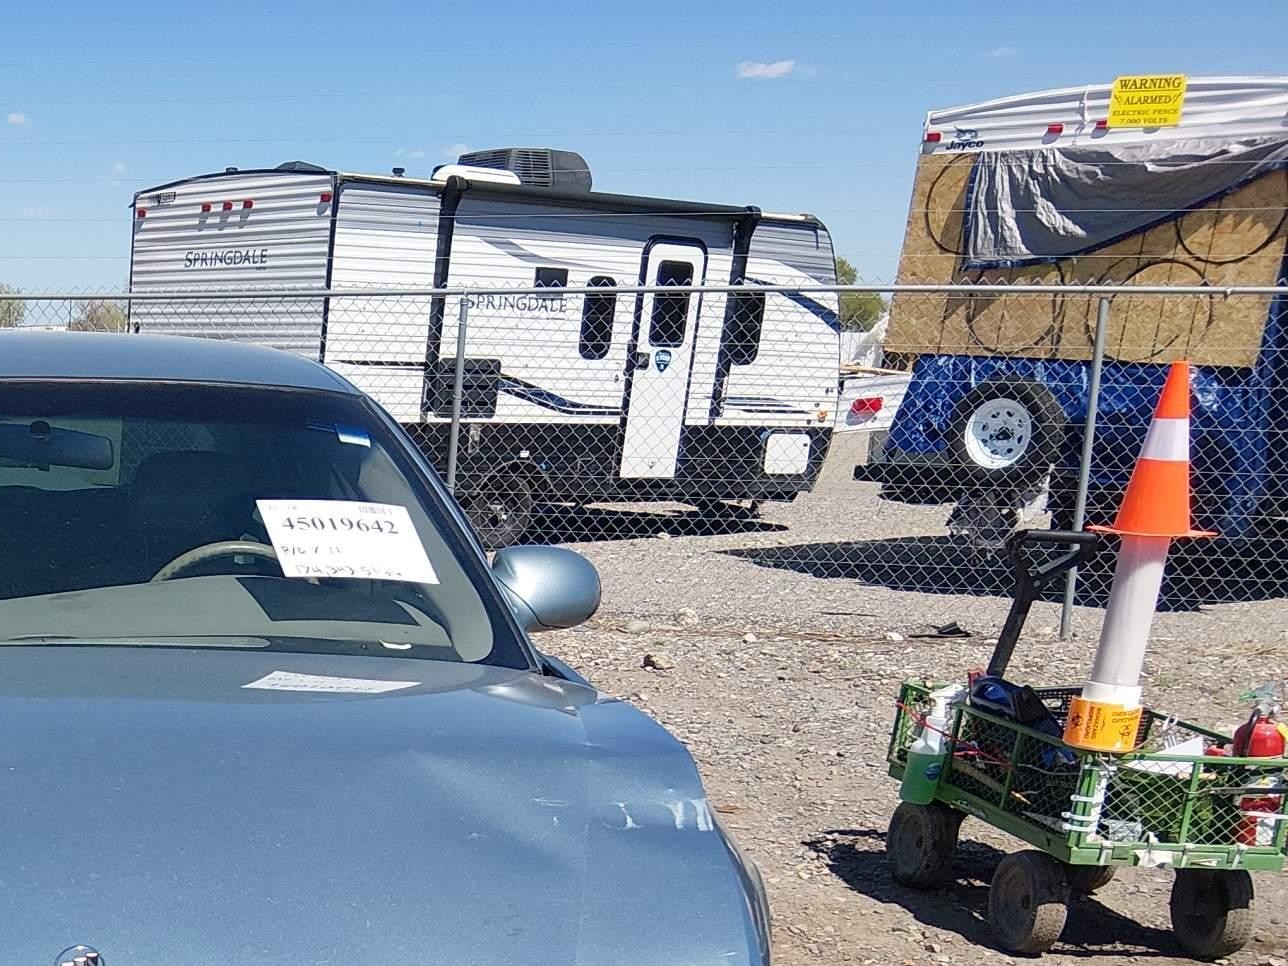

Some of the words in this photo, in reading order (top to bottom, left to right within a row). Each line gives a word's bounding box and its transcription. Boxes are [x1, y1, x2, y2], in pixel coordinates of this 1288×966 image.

[1119, 77, 1182, 90] WARNING
[1124, 95, 1172, 105] ALARMED
[945, 141, 984, 151] Jayco
[184, 249, 268, 268] SPRINGDALE
[466, 294, 568, 313] SPRINGDALE
[282, 516, 399, 534] 45019642
